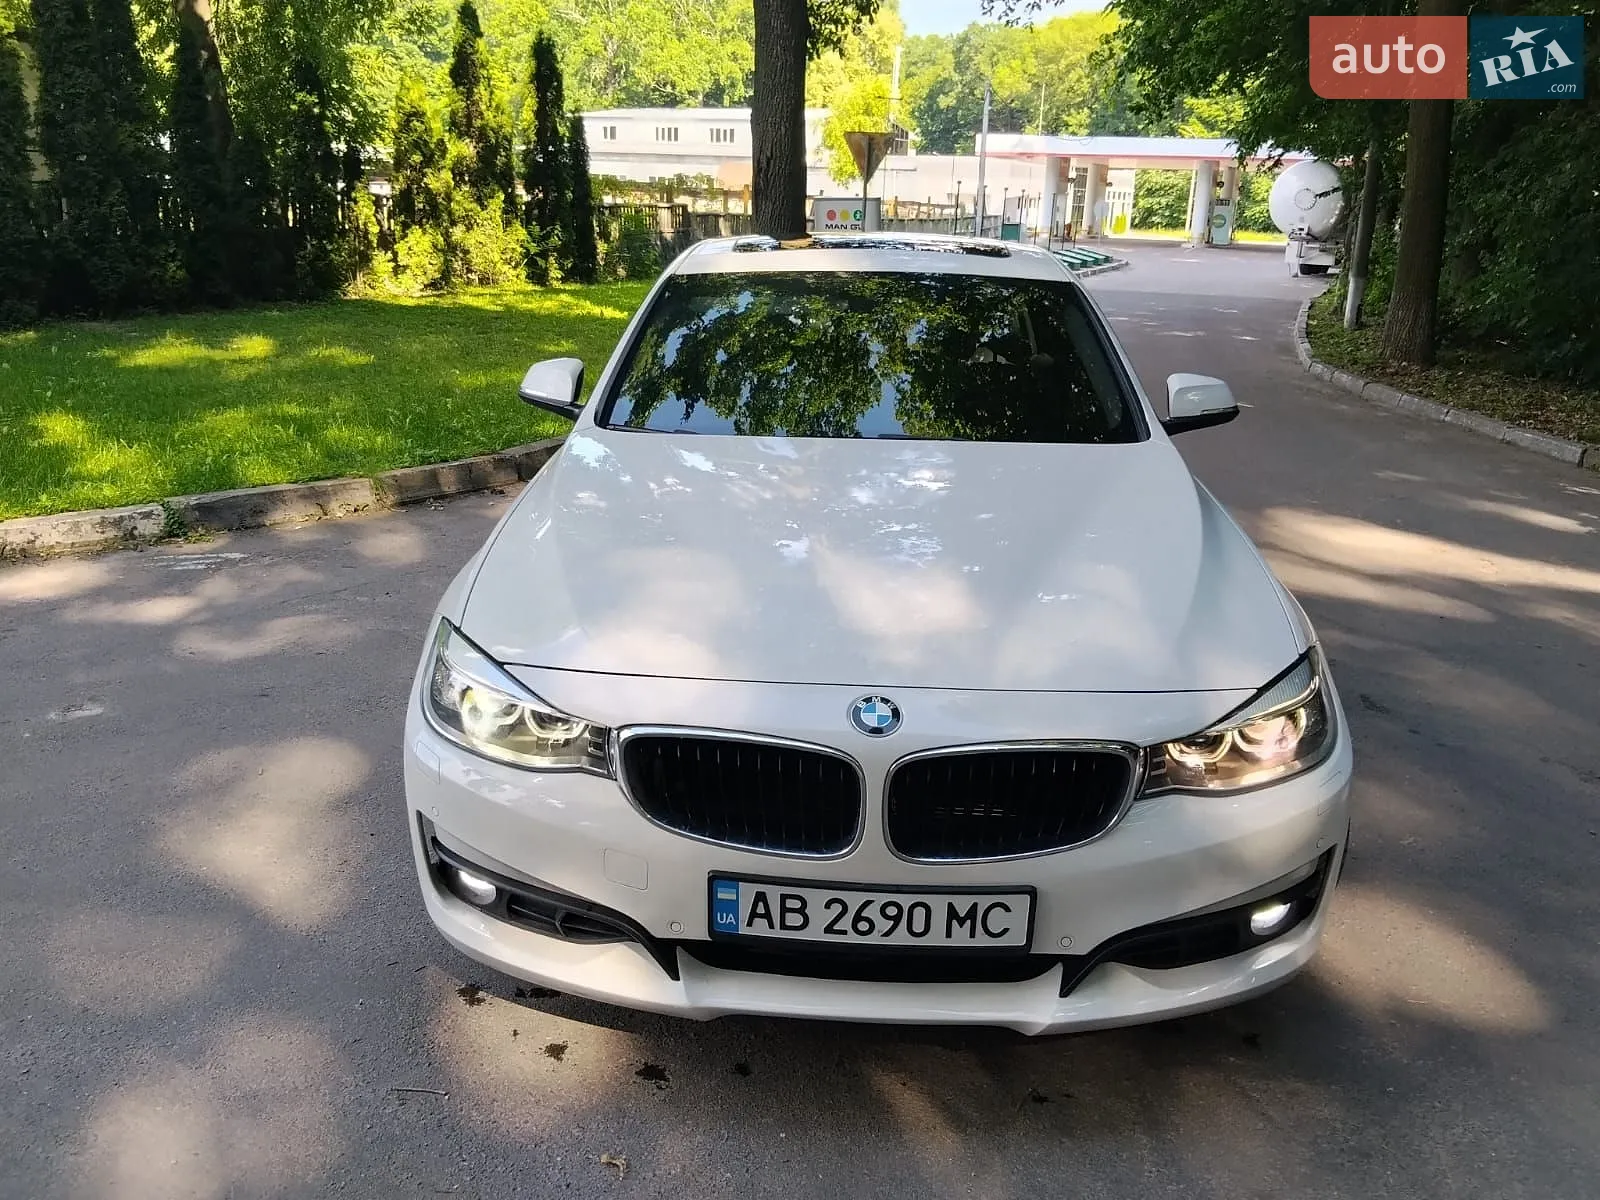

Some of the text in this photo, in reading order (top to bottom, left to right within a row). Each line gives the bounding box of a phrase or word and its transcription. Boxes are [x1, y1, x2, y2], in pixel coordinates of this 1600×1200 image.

[856, 696, 897, 710] BMW
[717, 911, 736, 926] UA
[745, 890, 1012, 939] AB 2690 MC
